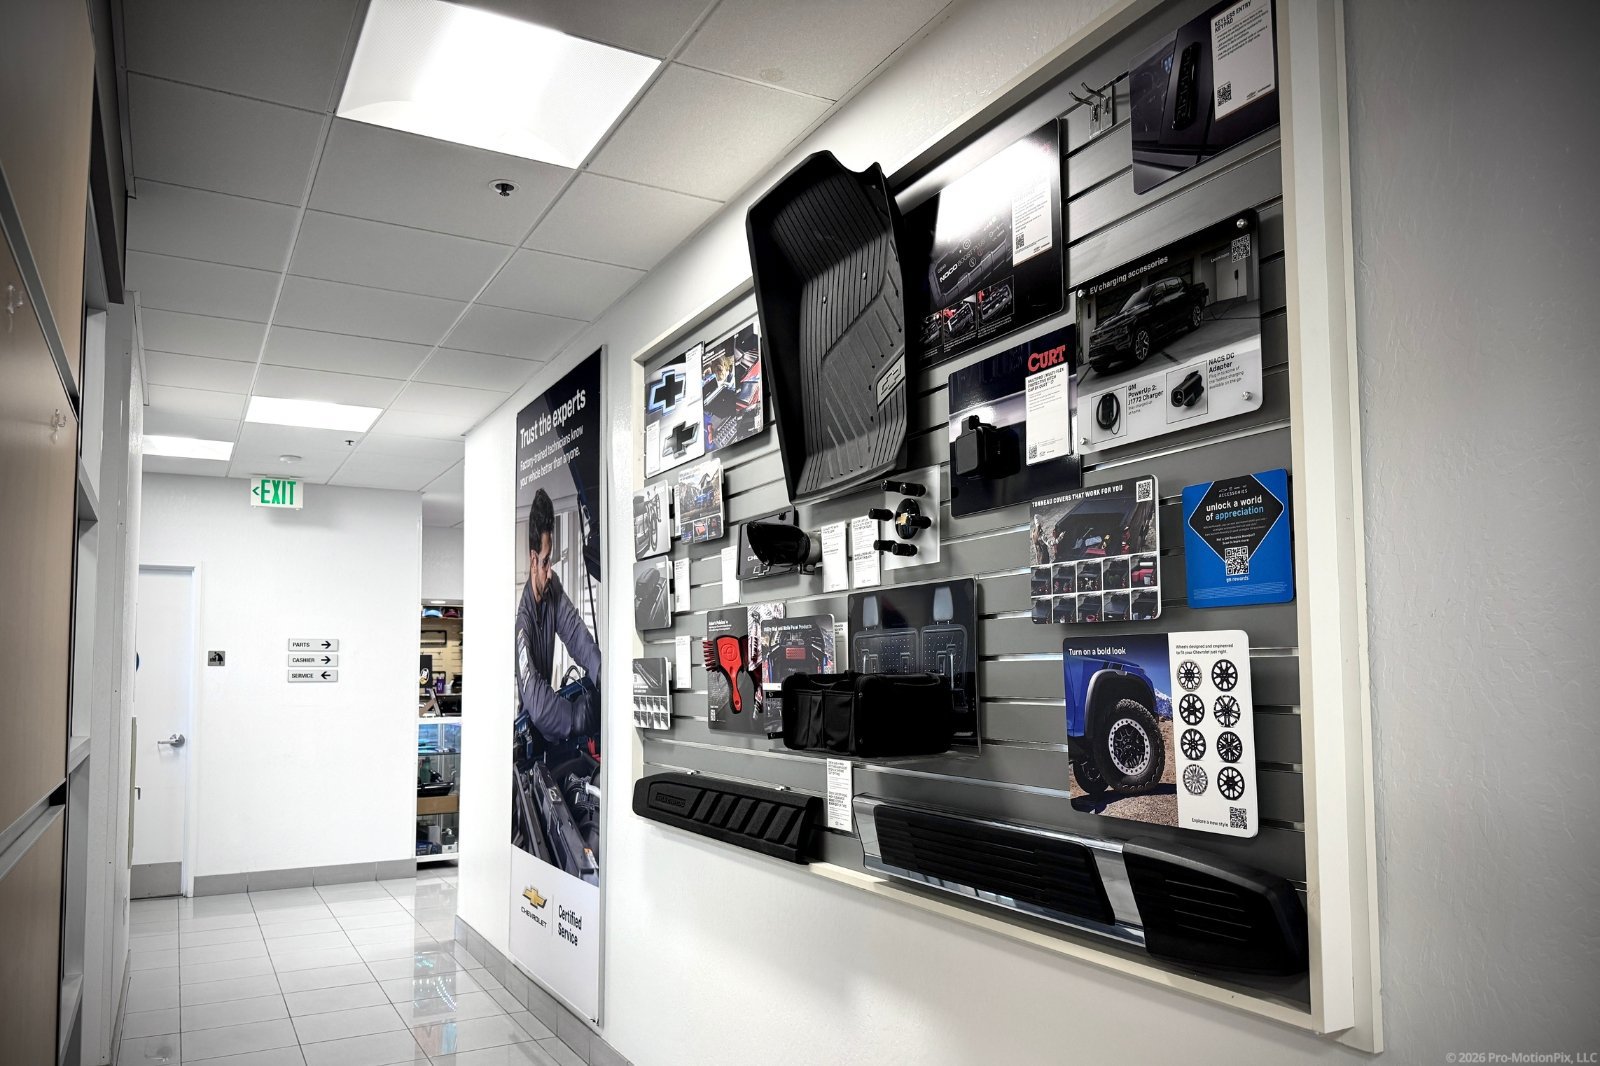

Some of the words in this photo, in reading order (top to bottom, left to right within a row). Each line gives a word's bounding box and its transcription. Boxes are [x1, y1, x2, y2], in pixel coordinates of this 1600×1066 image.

[1214, 10, 1236, 27] KEYLESS
[1235, 1, 1251, 15] ENTRY
[1214, 17, 1234, 33] KEYPAD
[940, 263, 958, 283] NOCO
[1089, 284, 1098, 295] EV
[1098, 274, 1127, 291] charging
[1127, 256, 1168, 279] accessories
[1027, 344, 1066, 372] CURT
[1208, 355, 1225, 366] NACS
[1225, 352, 1235, 361] DC
[1208, 361, 1233, 373] Adapter
[1128, 387, 1151, 398] PowerUp
[1142, 390, 1164, 401] Charger
[520, 420, 538, 449] Trust
[539, 412, 552, 437] the
[552, 389, 586, 427] experts
[520, 445, 547, 472] Factory-trained
[547, 434, 571, 456] technicians
[570, 425, 584, 441] know
[520, 476, 529, 490] your
[528, 467, 541, 482] vehicle
[540, 462, 553, 476] better
[553, 456, 563, 470] than
[563, 446, 581, 464] anyone.
[261, 479, 297, 505] EXIT
[1053, 495, 1071, 504] COVERS
[1072, 491, 1084, 500] THAT
[1085, 488, 1100, 497] WORK
[1101, 486, 1112, 494] FOR
[1112, 484, 1123, 492] YOU
[1218, 489, 1248, 498] ACCESSORIES
[1206, 501, 1231, 512] unlock
[1233, 500, 1238, 508] a
[1240, 494, 1262, 506] world
[1205, 513, 1214, 522] of
[1215, 505, 1264, 520] appreciation
[1068, 648, 1083, 656] Turn
[1096, 647, 1111, 655] bold
[1111, 646, 1127, 655] look
[520, 906, 547, 929] CHEVROLET
[558, 904, 582, 931] Certified
[557, 922, 578, 947] Service
